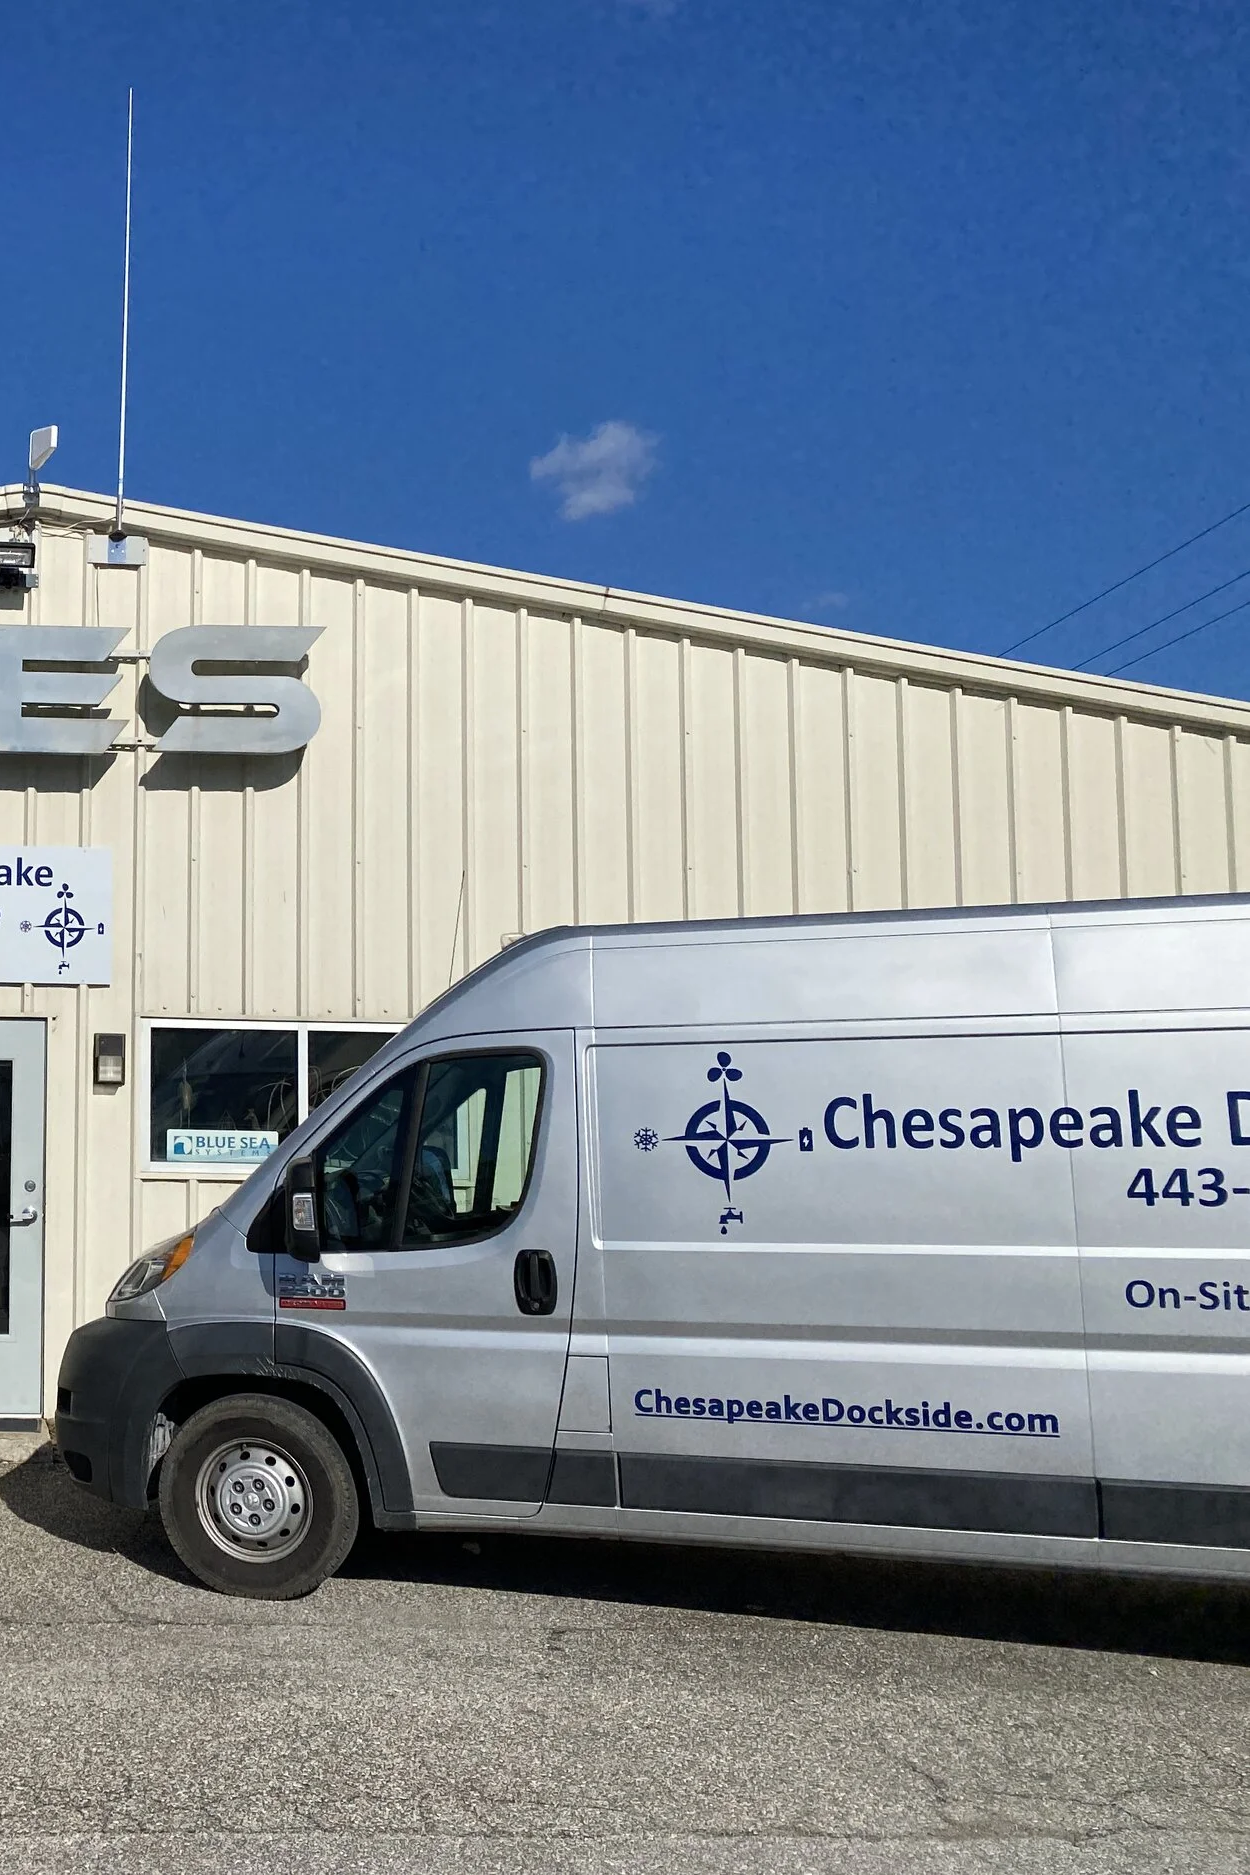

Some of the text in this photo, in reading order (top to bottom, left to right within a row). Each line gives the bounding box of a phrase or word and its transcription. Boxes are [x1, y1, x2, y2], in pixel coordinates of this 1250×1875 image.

[196, 1136, 270, 1149] BLUE SEA
[823, 1089, 1202, 1163] Chesapeake
[1126, 1167, 1250, 1207] 443-
[1125, 1279, 1250, 1311] On-Sit
[634, 1388, 1060, 1437] ChesapeakeDockside.com
